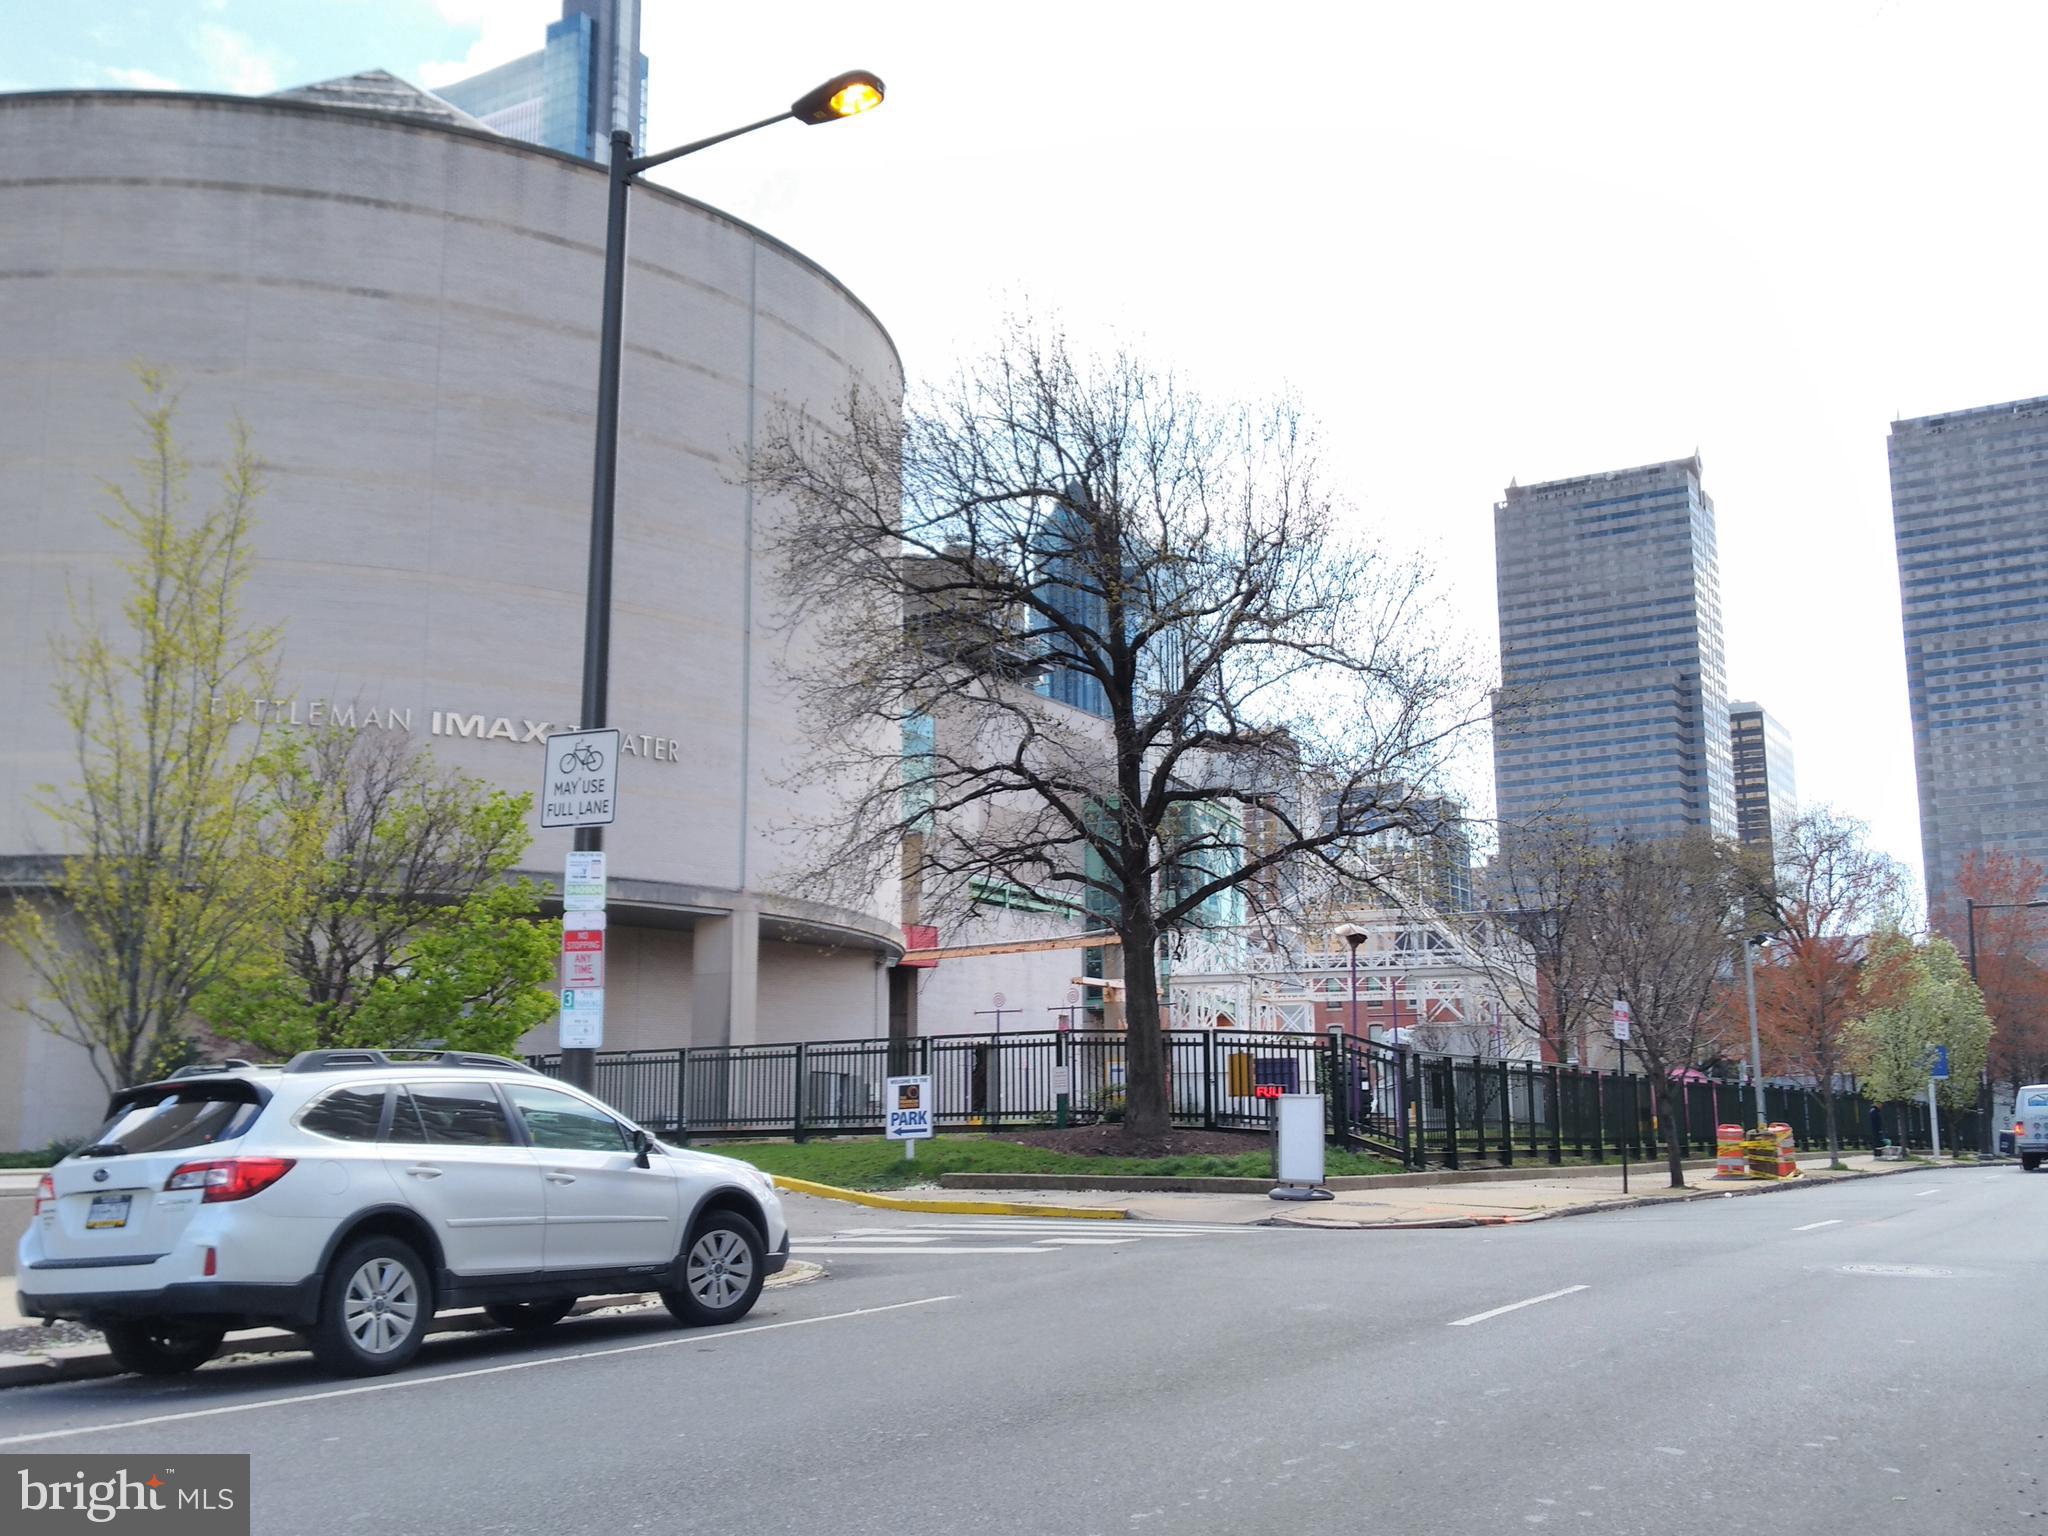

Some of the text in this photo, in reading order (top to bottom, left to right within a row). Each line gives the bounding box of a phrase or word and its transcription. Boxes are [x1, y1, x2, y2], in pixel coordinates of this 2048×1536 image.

[431, 711, 550, 744] IMAX
[568, 725, 680, 762] TATER
[553, 778, 605, 796] MAY USE
[546, 800, 609, 817] FULL LANE
[577, 932, 589, 940] NO
[574, 953, 592, 963] ANY
[574, 964, 593, 974] TIME
[565, 991, 572, 1006] 3
[891, 1110, 927, 1126] PARK
